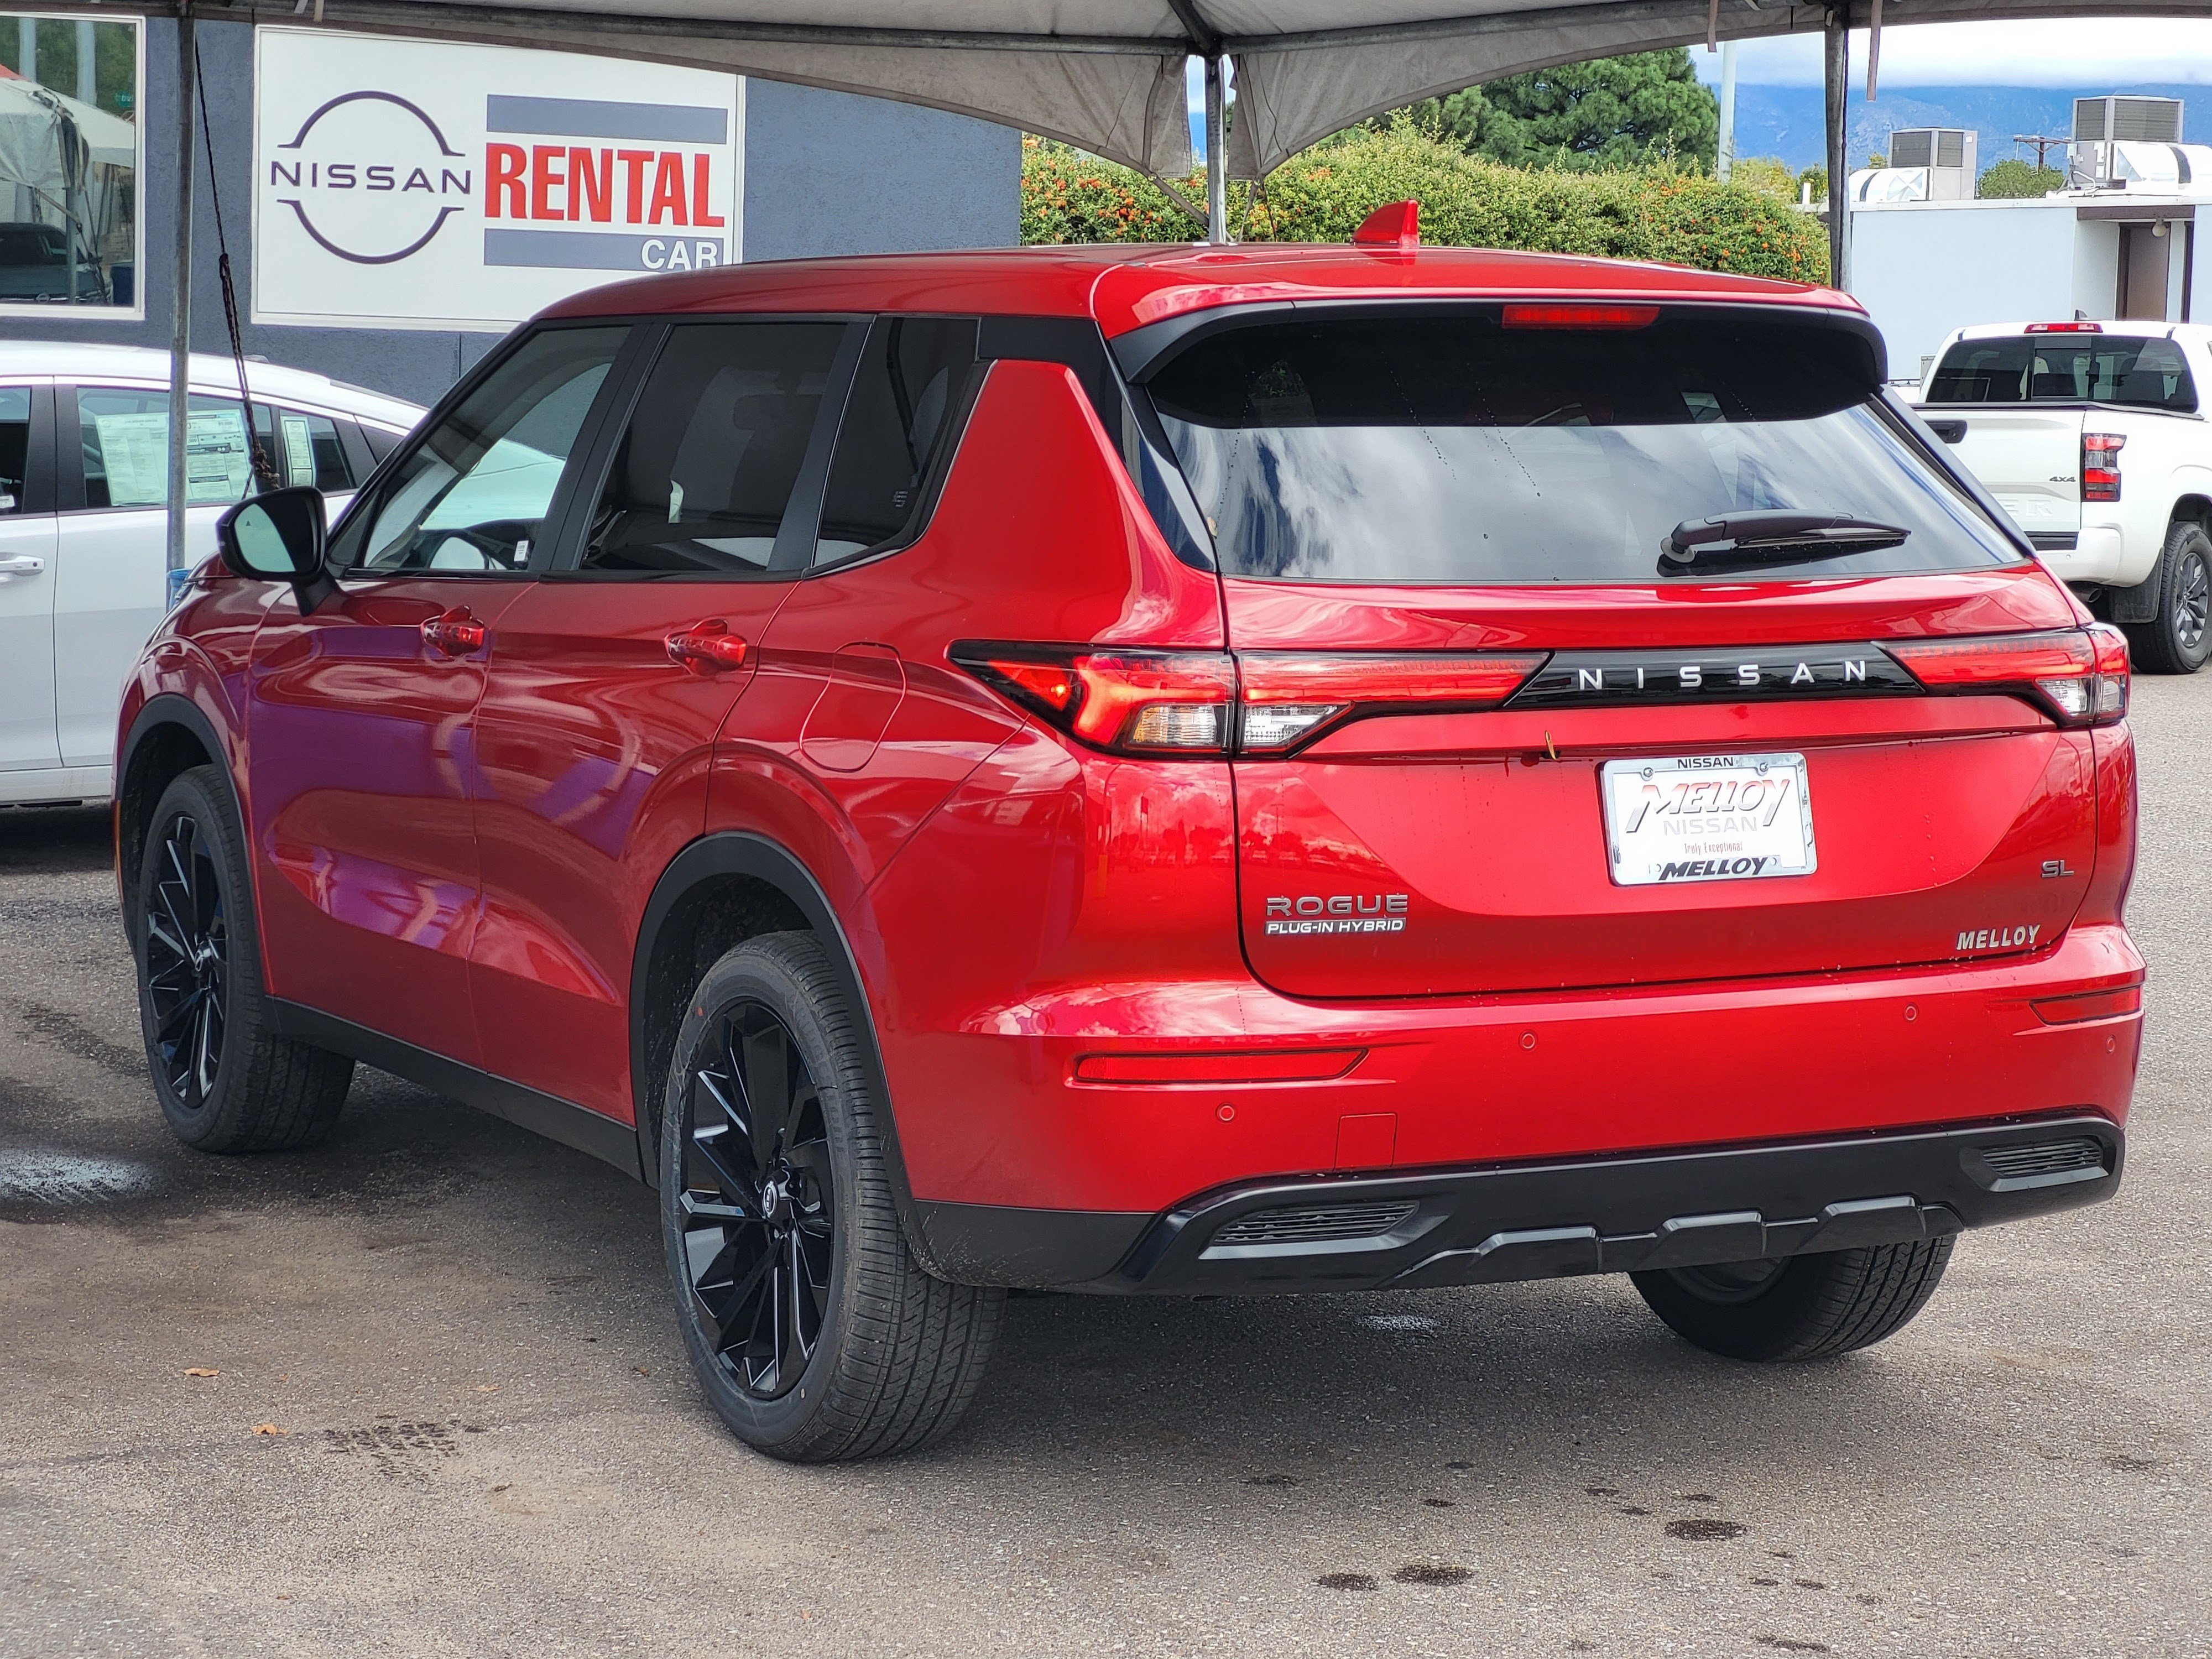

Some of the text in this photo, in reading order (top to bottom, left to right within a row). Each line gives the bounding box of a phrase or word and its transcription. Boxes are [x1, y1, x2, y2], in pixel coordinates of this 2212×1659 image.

[272, 160, 471, 195] NISSAN
[484, 142, 725, 228] RENTAL
[641, 239, 717, 272] CAR
[1578, 660, 1865, 690] NISSAN
[1677, 757, 1734, 769] NISSAN
[1663, 817, 1757, 836] NISSAN
[1684, 841, 1743, 855] Truly Exceptional
[1658, 857, 1768, 881] MELLOY
[2041, 860, 2074, 878] SL
[1266, 894, 1408, 916] ROGUE
[1267, 920, 1404, 934] PLUG-IN HYBRID
[1956, 924, 2041, 951] MELLOY
